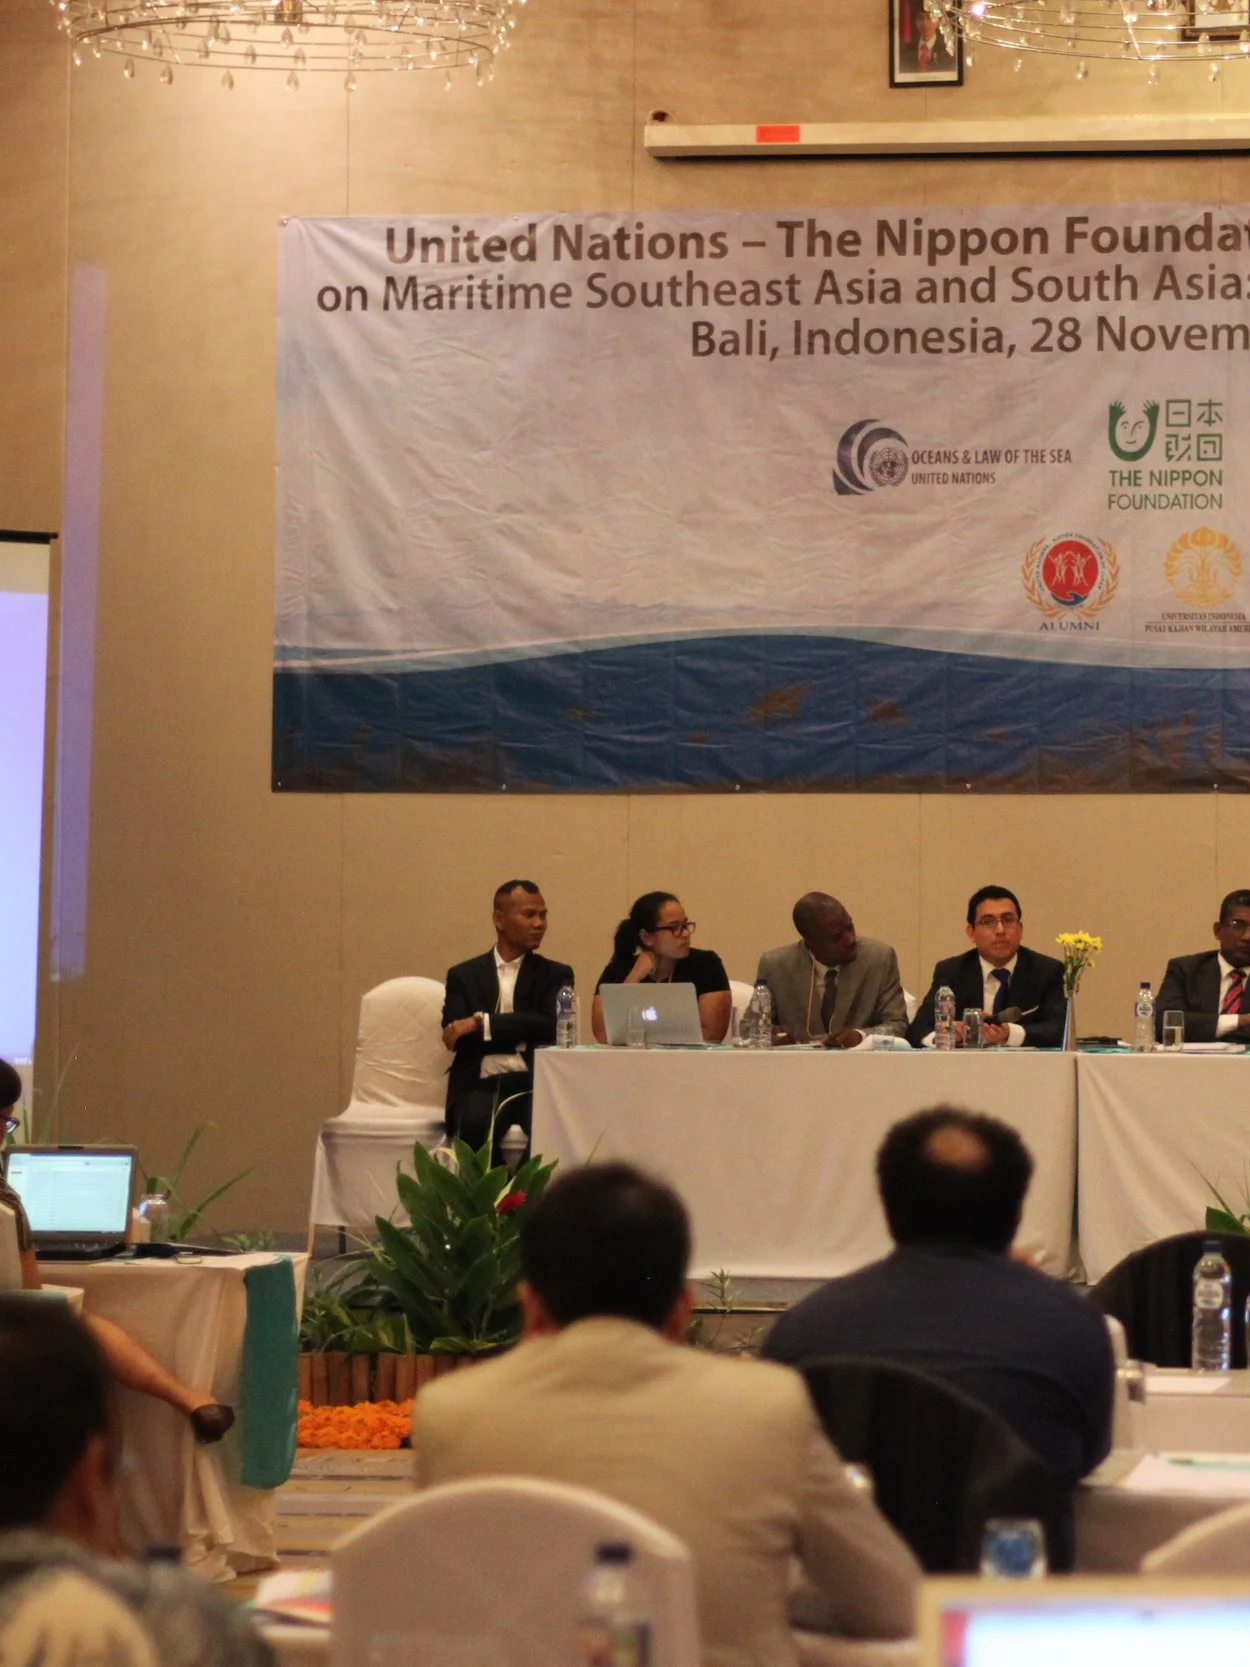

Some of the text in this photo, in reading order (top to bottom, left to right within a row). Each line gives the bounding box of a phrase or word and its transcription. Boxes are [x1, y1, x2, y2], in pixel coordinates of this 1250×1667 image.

[387, 223, 537, 263] United
[553, 222, 728, 260] Nations
[776, 219, 860, 257] The
[876, 217, 1048, 266] Nippon
[317, 286, 367, 312] on
[383, 274, 572, 311] Maritime
[587, 270, 800, 308] Southeast
[814, 268, 901, 304] Asia
[916, 264, 995, 304] and
[1012, 264, 1137, 302] South
[692, 319, 778, 361] Bali,
[794, 317, 1016, 358] Indonesia,
[1031, 317, 1081, 353] 28
[911, 449, 1072, 465] OCEANS & LAW OF THE SEA
[911, 472, 996, 485] UNITED NATIONS
[1109, 469, 1223, 487] THE NIPPON
[1108, 493, 1223, 510] FOUNDATION
[1039, 621, 1100, 630] ALUMNI
